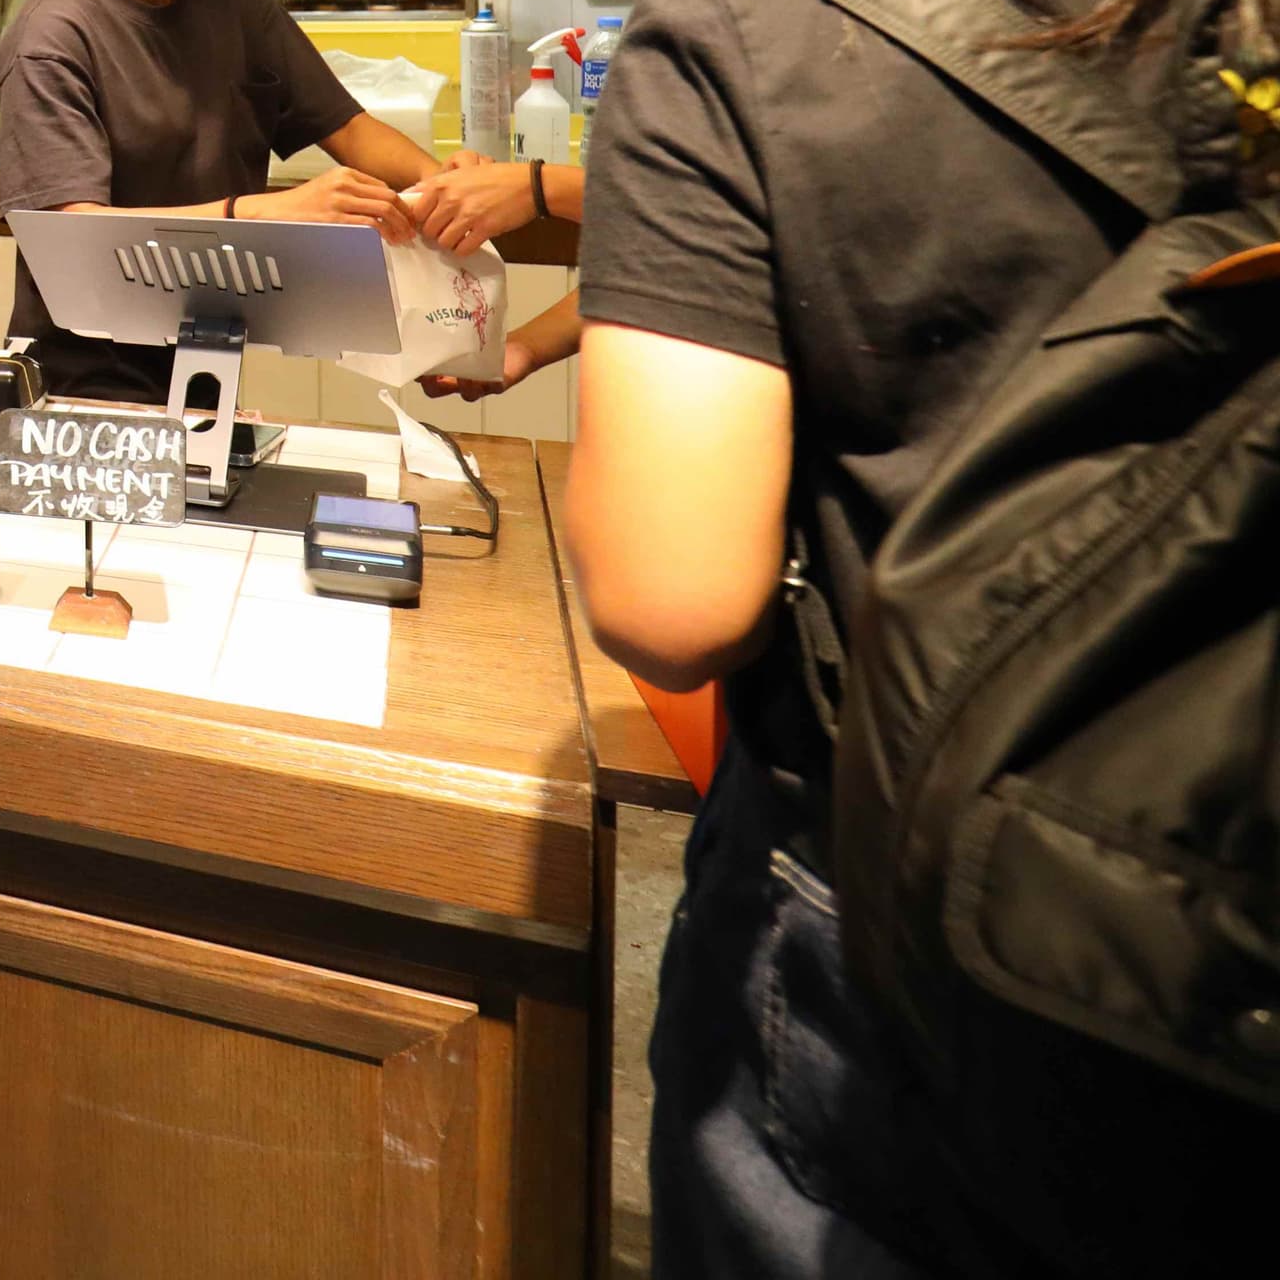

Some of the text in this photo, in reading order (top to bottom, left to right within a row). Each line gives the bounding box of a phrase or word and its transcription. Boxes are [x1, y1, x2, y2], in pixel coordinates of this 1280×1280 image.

[425, 307, 473, 323] VISSION
[22, 418, 182, 464] NO CASH
[0, 460, 175, 498] PAYMENT
